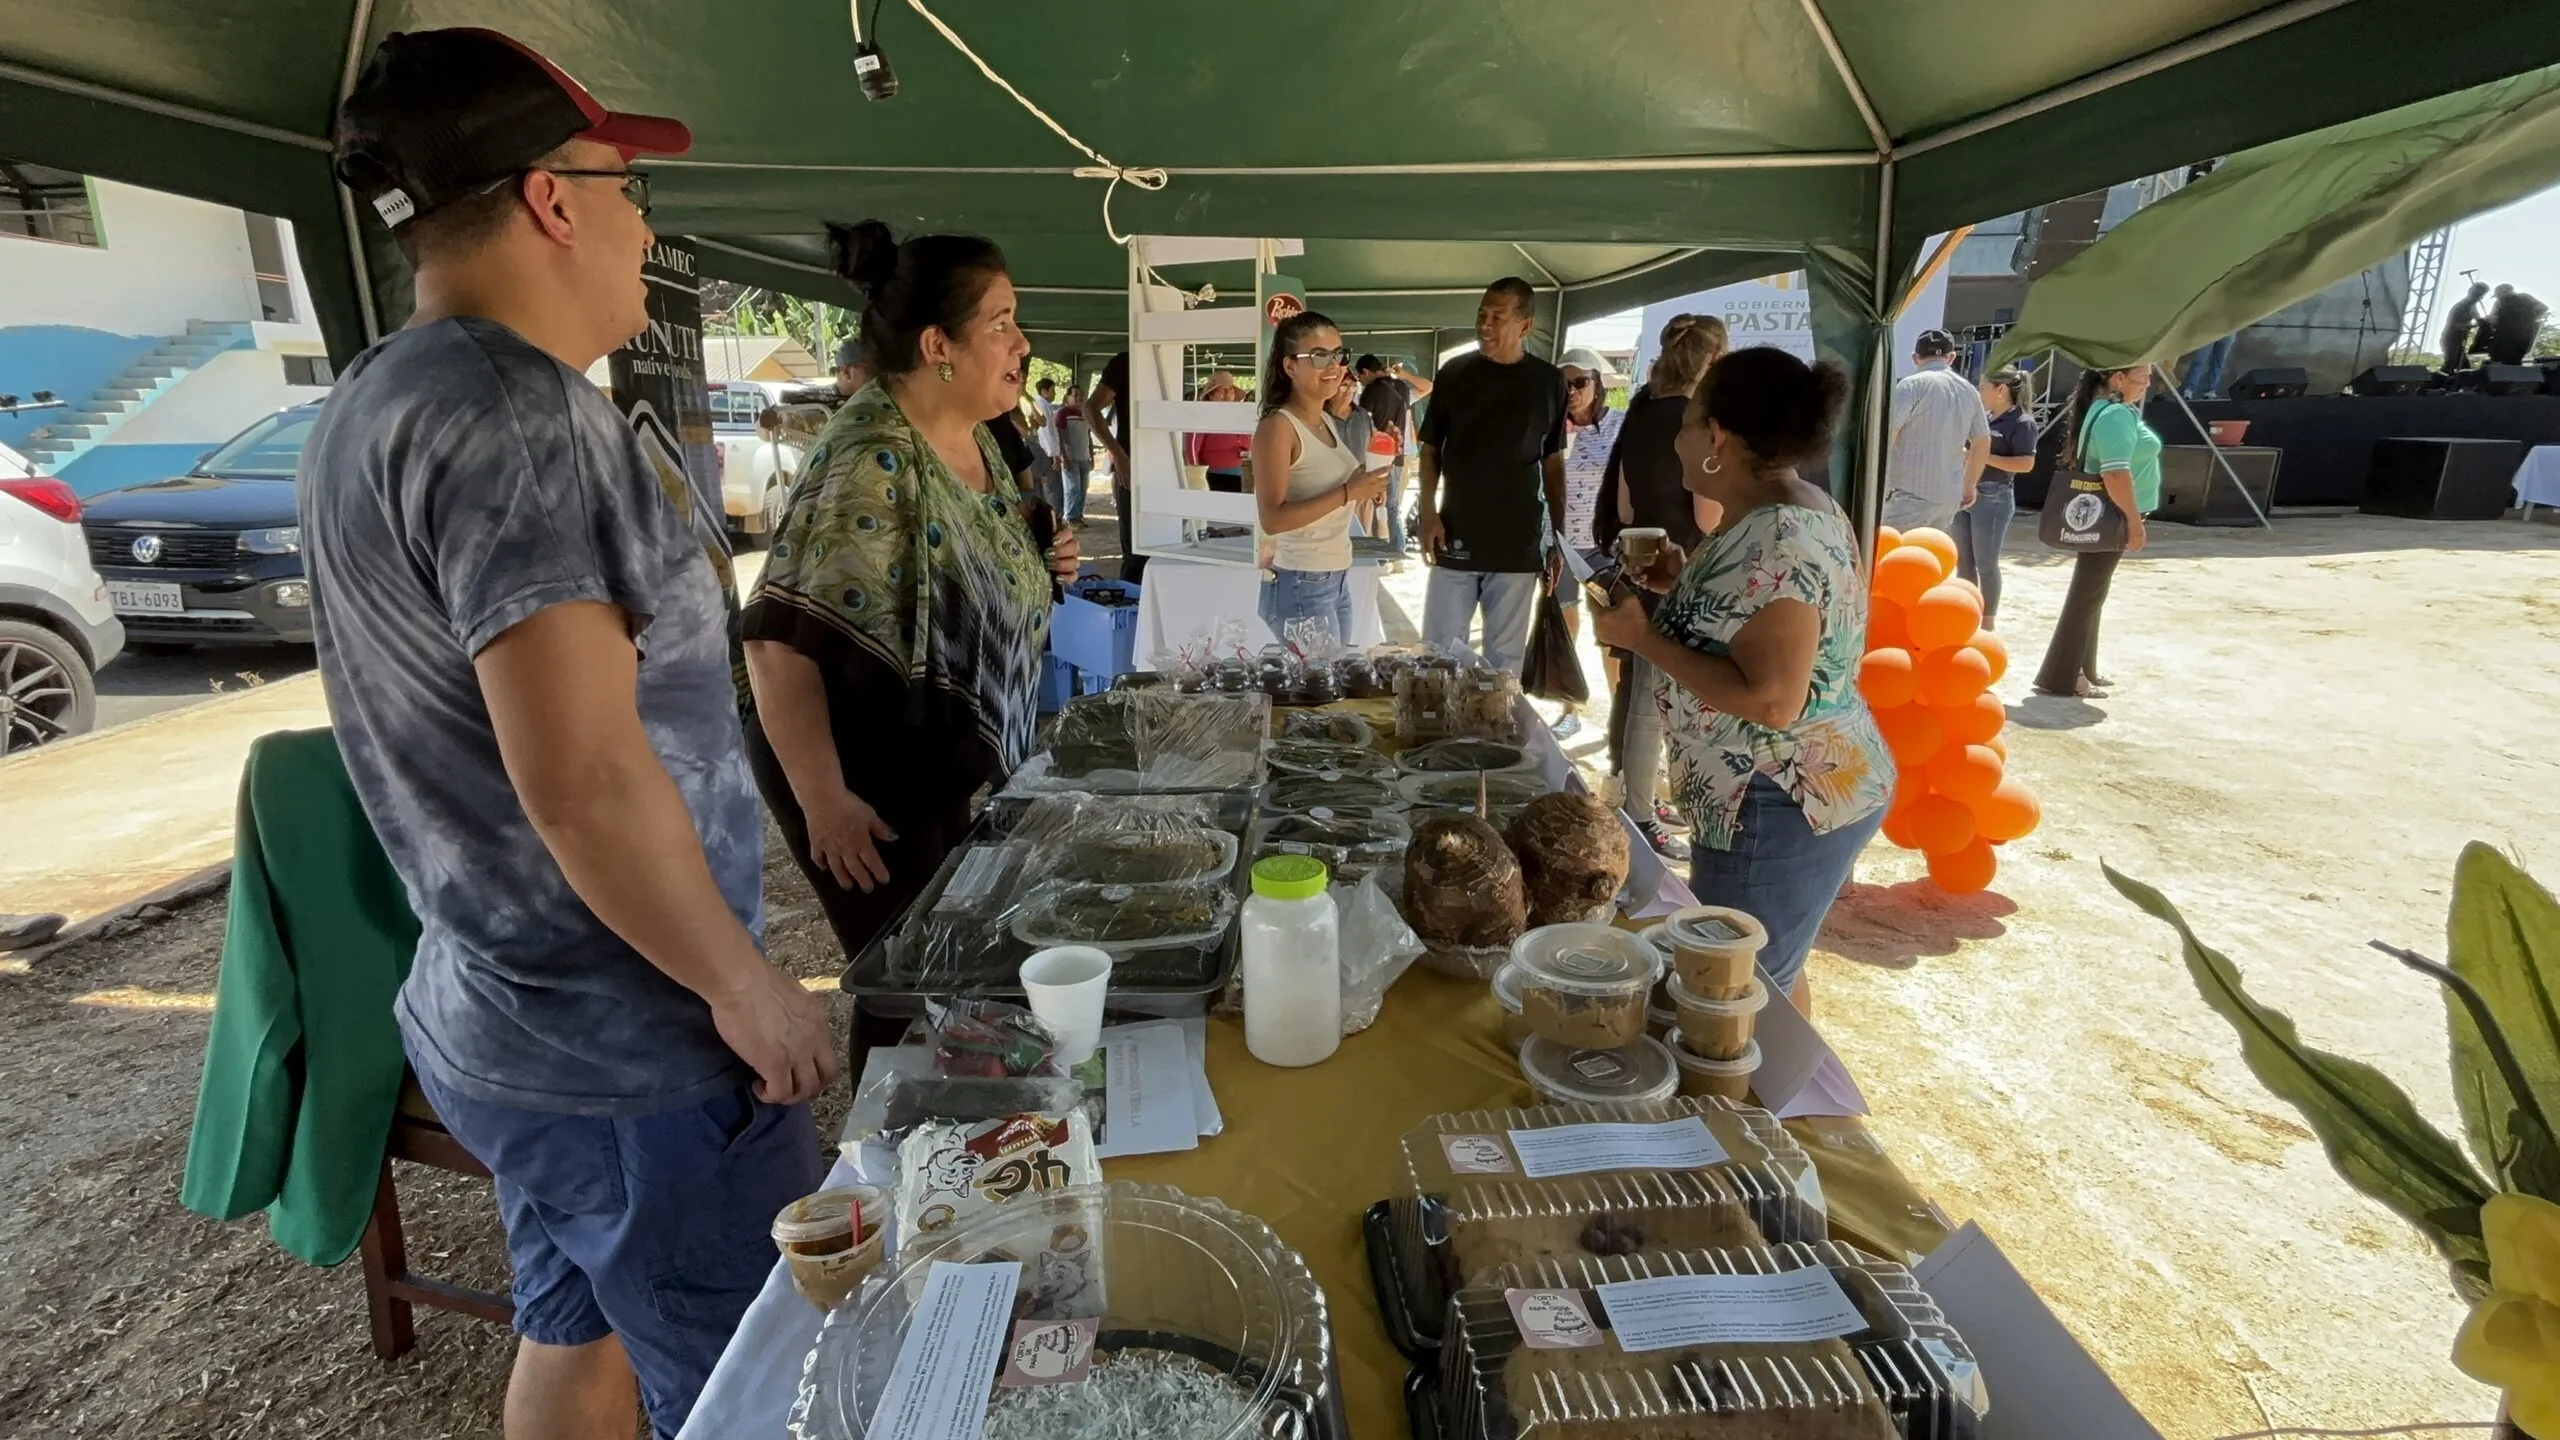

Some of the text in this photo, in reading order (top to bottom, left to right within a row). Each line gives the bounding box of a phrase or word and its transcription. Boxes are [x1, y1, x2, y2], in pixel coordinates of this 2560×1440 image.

[641, 243, 696, 277] LAMEC
[1725, 301, 1806, 310] GOBIERN
[1725, 312, 1811, 331] PASTA
[622, 318, 700, 361] UNUTI
[632, 356, 671, 376] native
[110, 591, 179, 608] TBI-6093
[1016, 1340, 1027, 1362] TORTA
